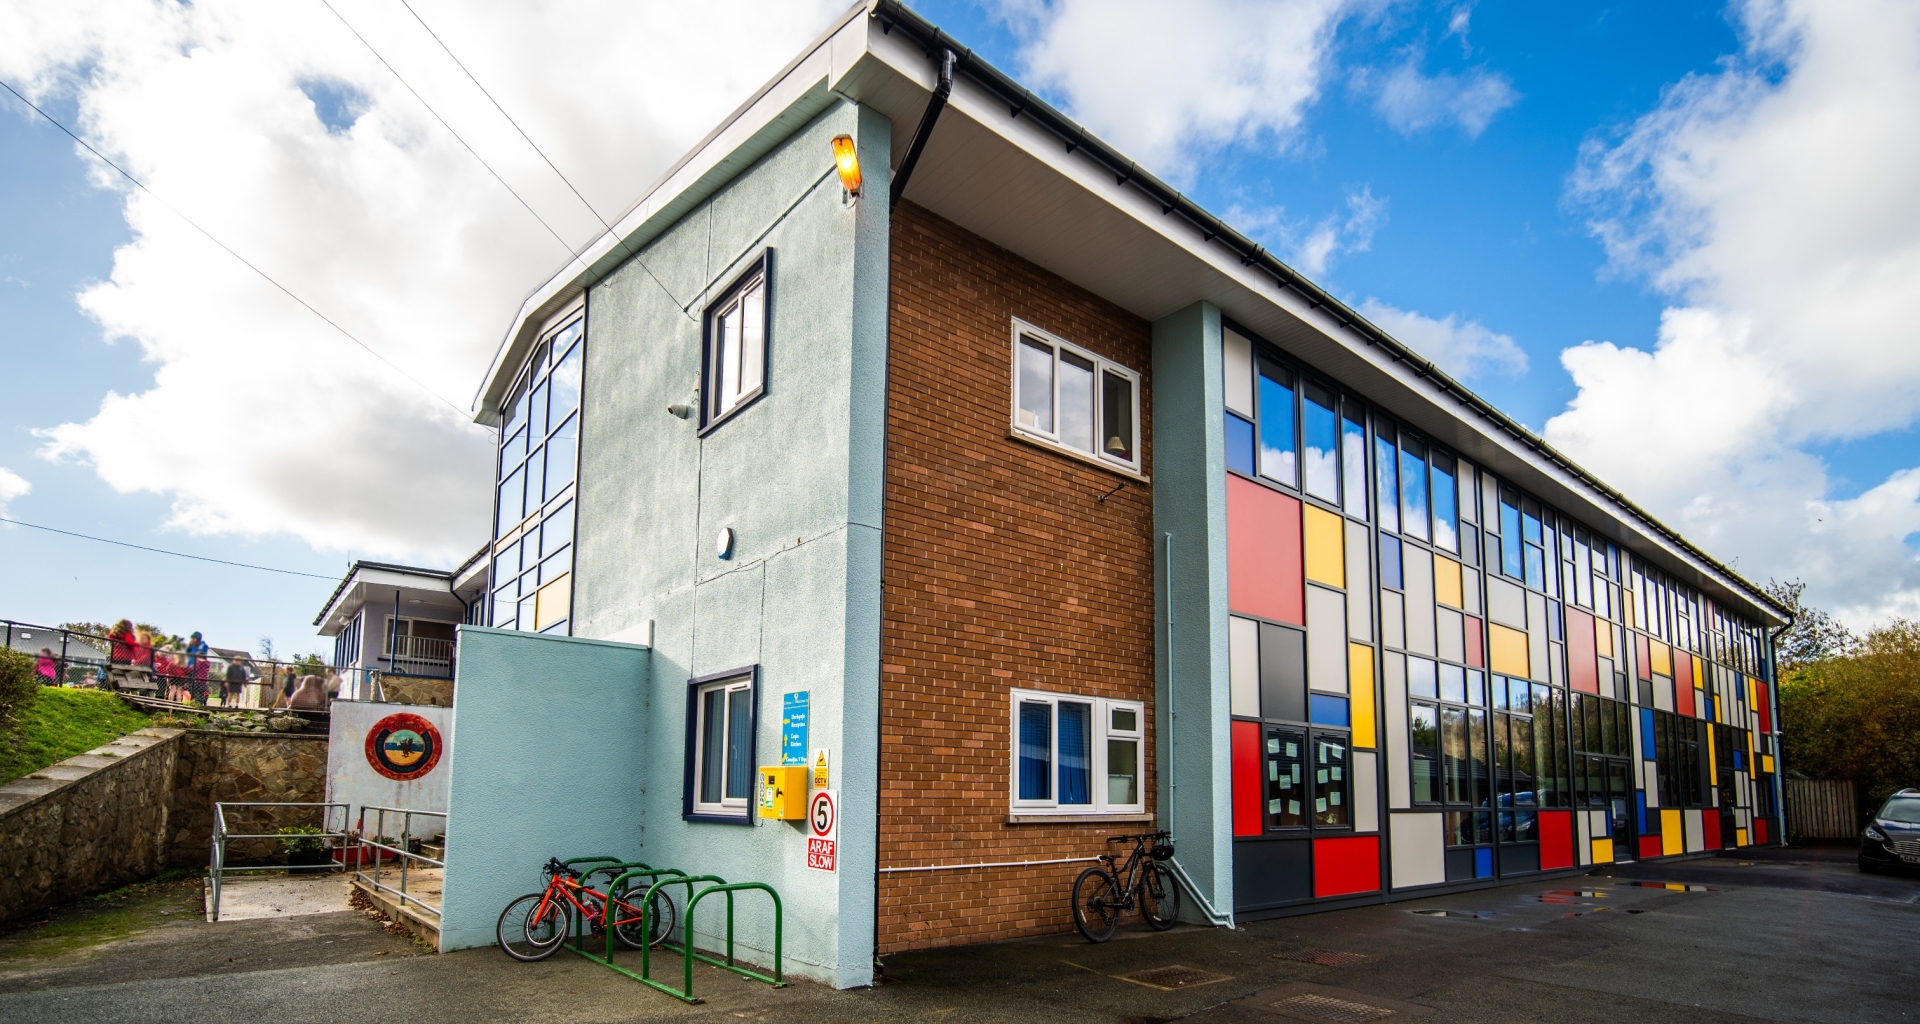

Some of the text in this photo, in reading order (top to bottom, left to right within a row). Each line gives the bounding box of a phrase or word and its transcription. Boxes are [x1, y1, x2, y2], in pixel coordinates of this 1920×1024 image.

[817, 801, 828, 830] 5
[810, 840, 833, 855] ARAF
[809, 854, 833, 869] SLOW
